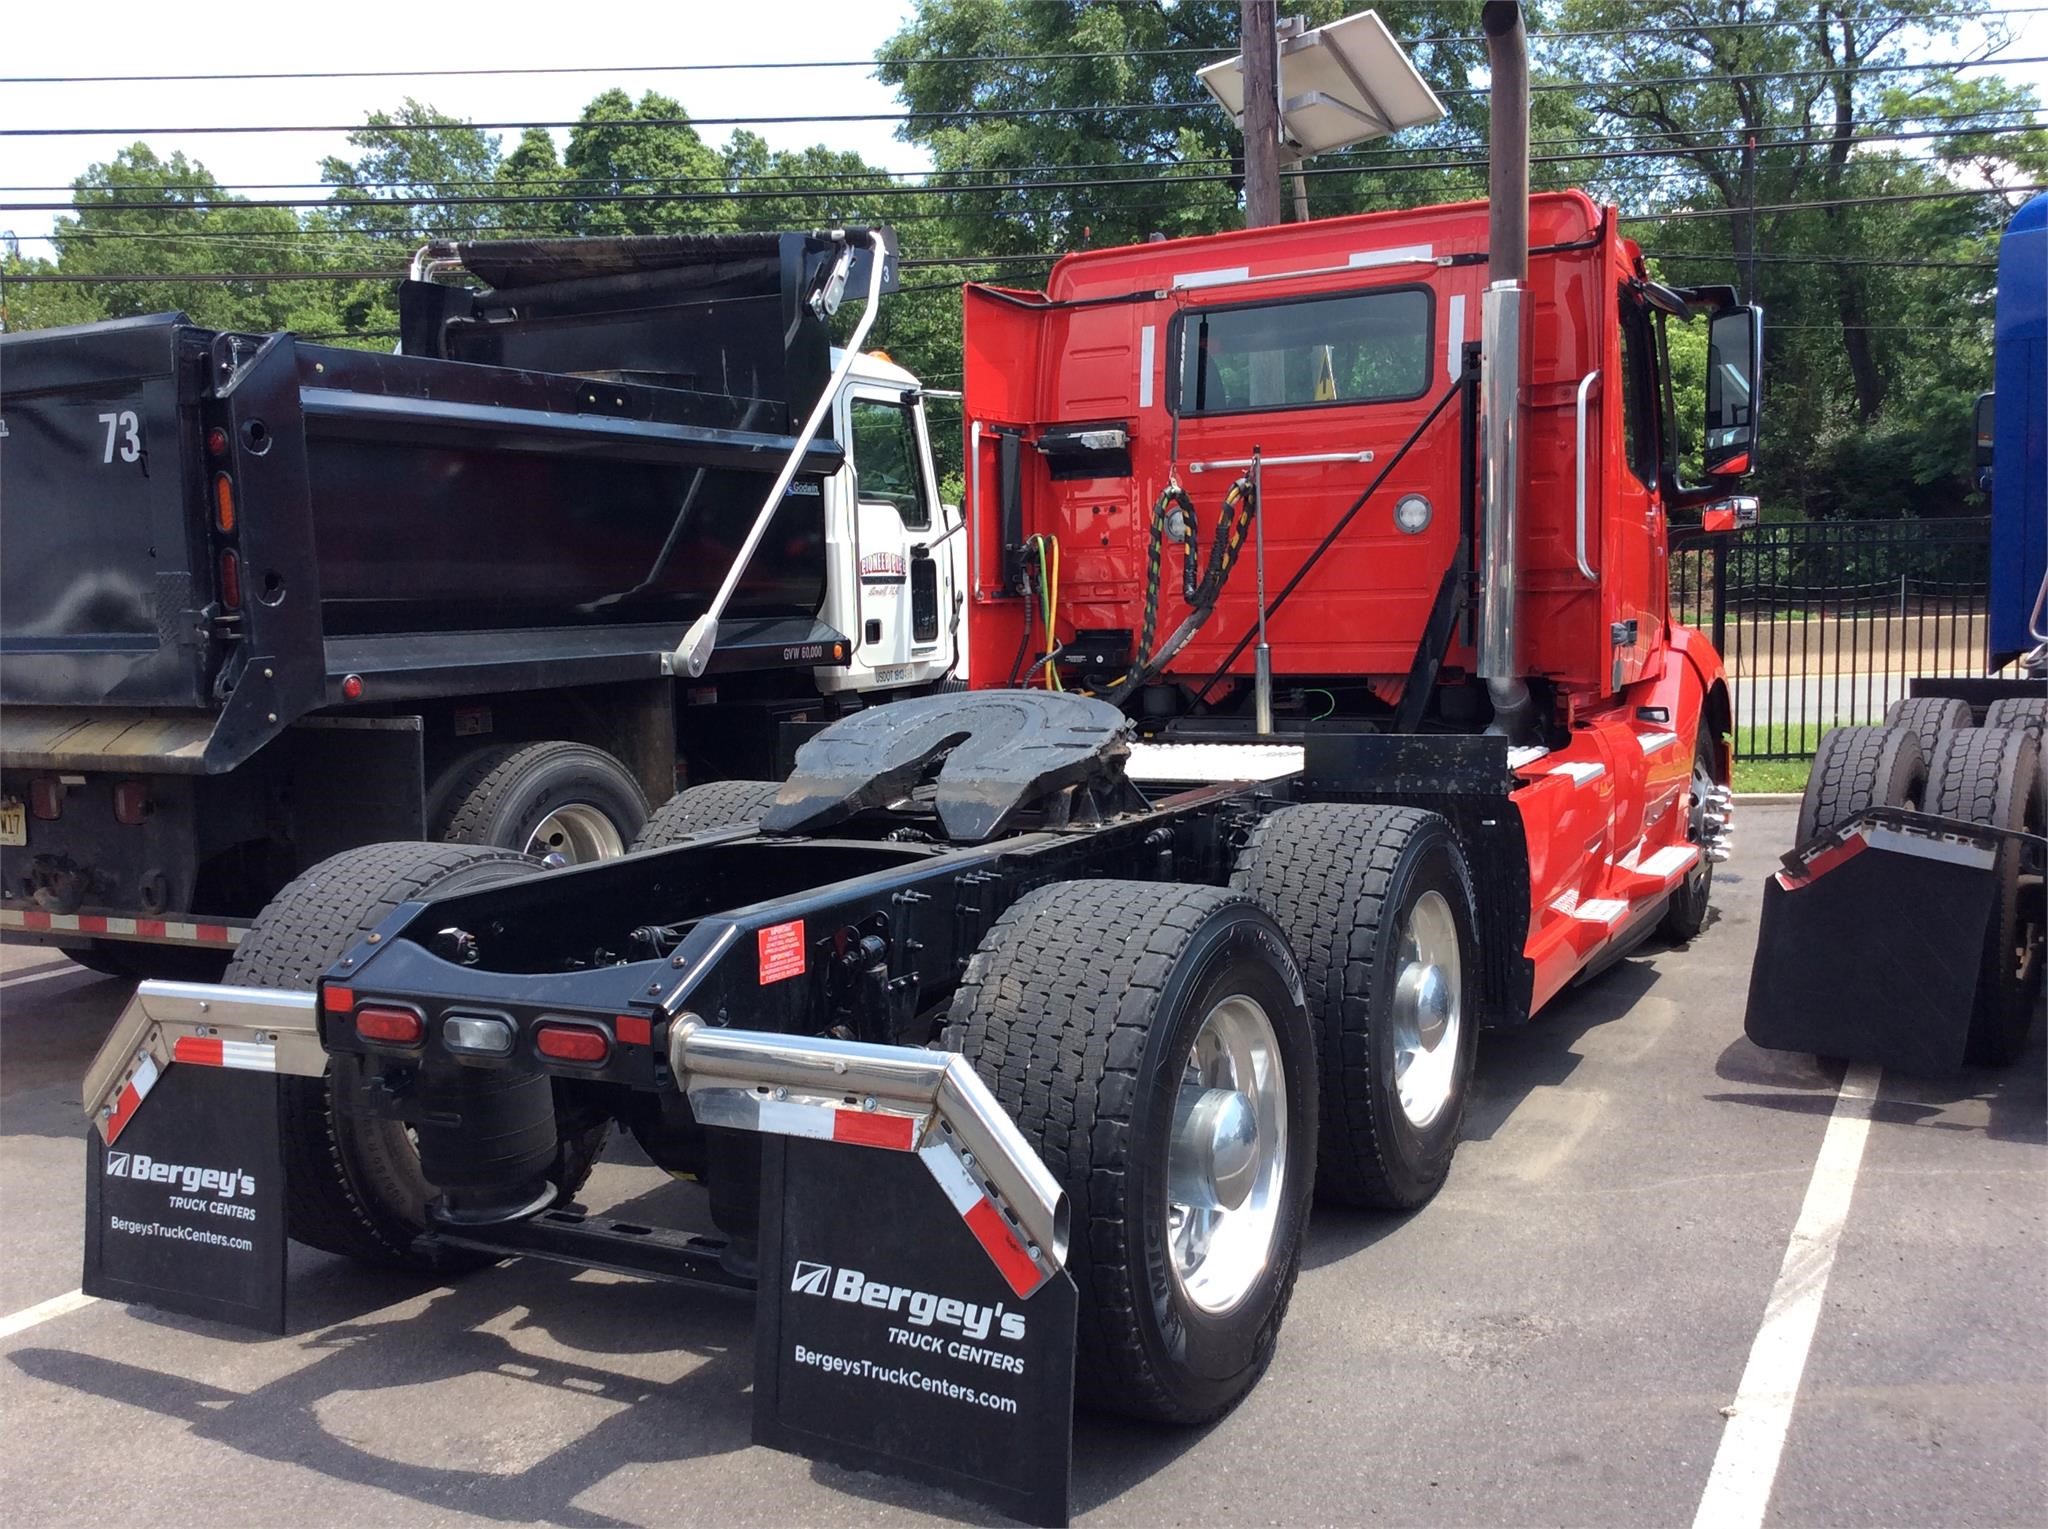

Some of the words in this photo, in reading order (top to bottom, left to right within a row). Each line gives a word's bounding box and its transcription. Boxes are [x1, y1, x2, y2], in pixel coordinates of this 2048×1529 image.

[98, 411, 141, 464] 73
[783, 647, 800, 660] GVW
[801, 645, 822, 659] 60,000
[131, 1154, 255, 1197] Bergey's
[169, 1195, 207, 1212] TRUCK
[209, 1201, 256, 1221] CENTERS
[111, 1216, 253, 1251] BergeysTruckCenters.com
[832, 1268, 1026, 1340] Bergey's
[888, 1327, 944, 1354] TRUCK
[947, 1341, 1025, 1375] CENTERS
[795, 1344, 1017, 1414] BergeysTruckCenters.com
